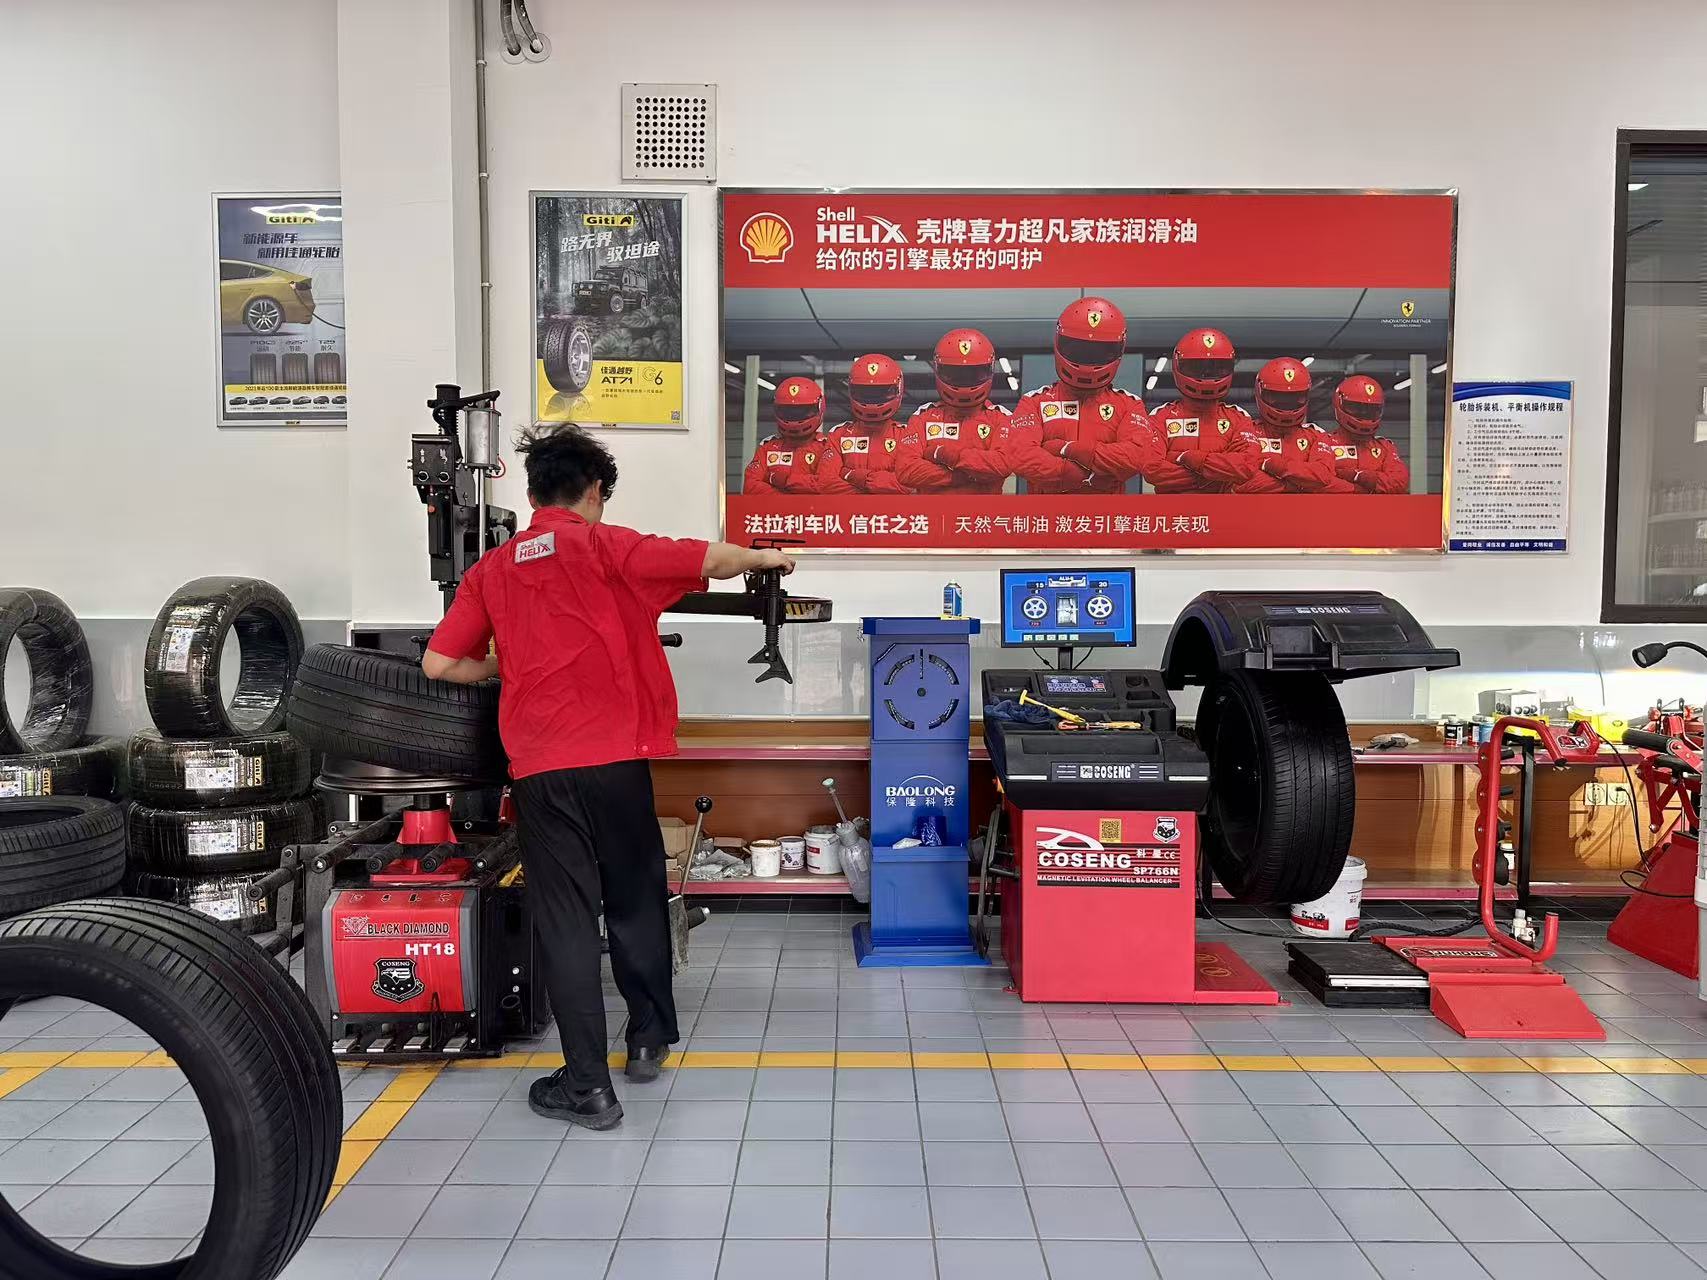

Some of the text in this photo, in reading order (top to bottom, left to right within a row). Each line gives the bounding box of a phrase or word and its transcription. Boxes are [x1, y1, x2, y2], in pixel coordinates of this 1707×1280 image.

[586, 216, 616, 225] Giti
[816, 207, 855, 222] Shell
[816, 215, 1198, 244] HELIX 壳牌喜力超凡家族润滑油
[242, 232, 299, 245] 新能源车
[561, 231, 613, 253] 路无界
[606, 241, 660, 263] 驭坦途
[816, 248, 1043, 271] 给你的引擎最好的呵护
[601, 376, 633, 385] AT71
[1459, 402, 1564, 412] 轮胎拆装机、平衡机操作规程
[744, 514, 1211, 535] 法拉利车队 信任之选 天然气制油 激发引擎超凡表现
[519, 543, 551, 558] HELIX
[1094, 765, 1131, 779] COSENG
[886, 785, 956, 797] BAOLONG
[886, 797, 954, 807] 保隆科技
[1038, 852, 1131, 868] COSENG
[1133, 866, 1179, 876] SP766N
[367, 923, 449, 934] BLACK DIAMOND
[405, 943, 455, 956] HT18
